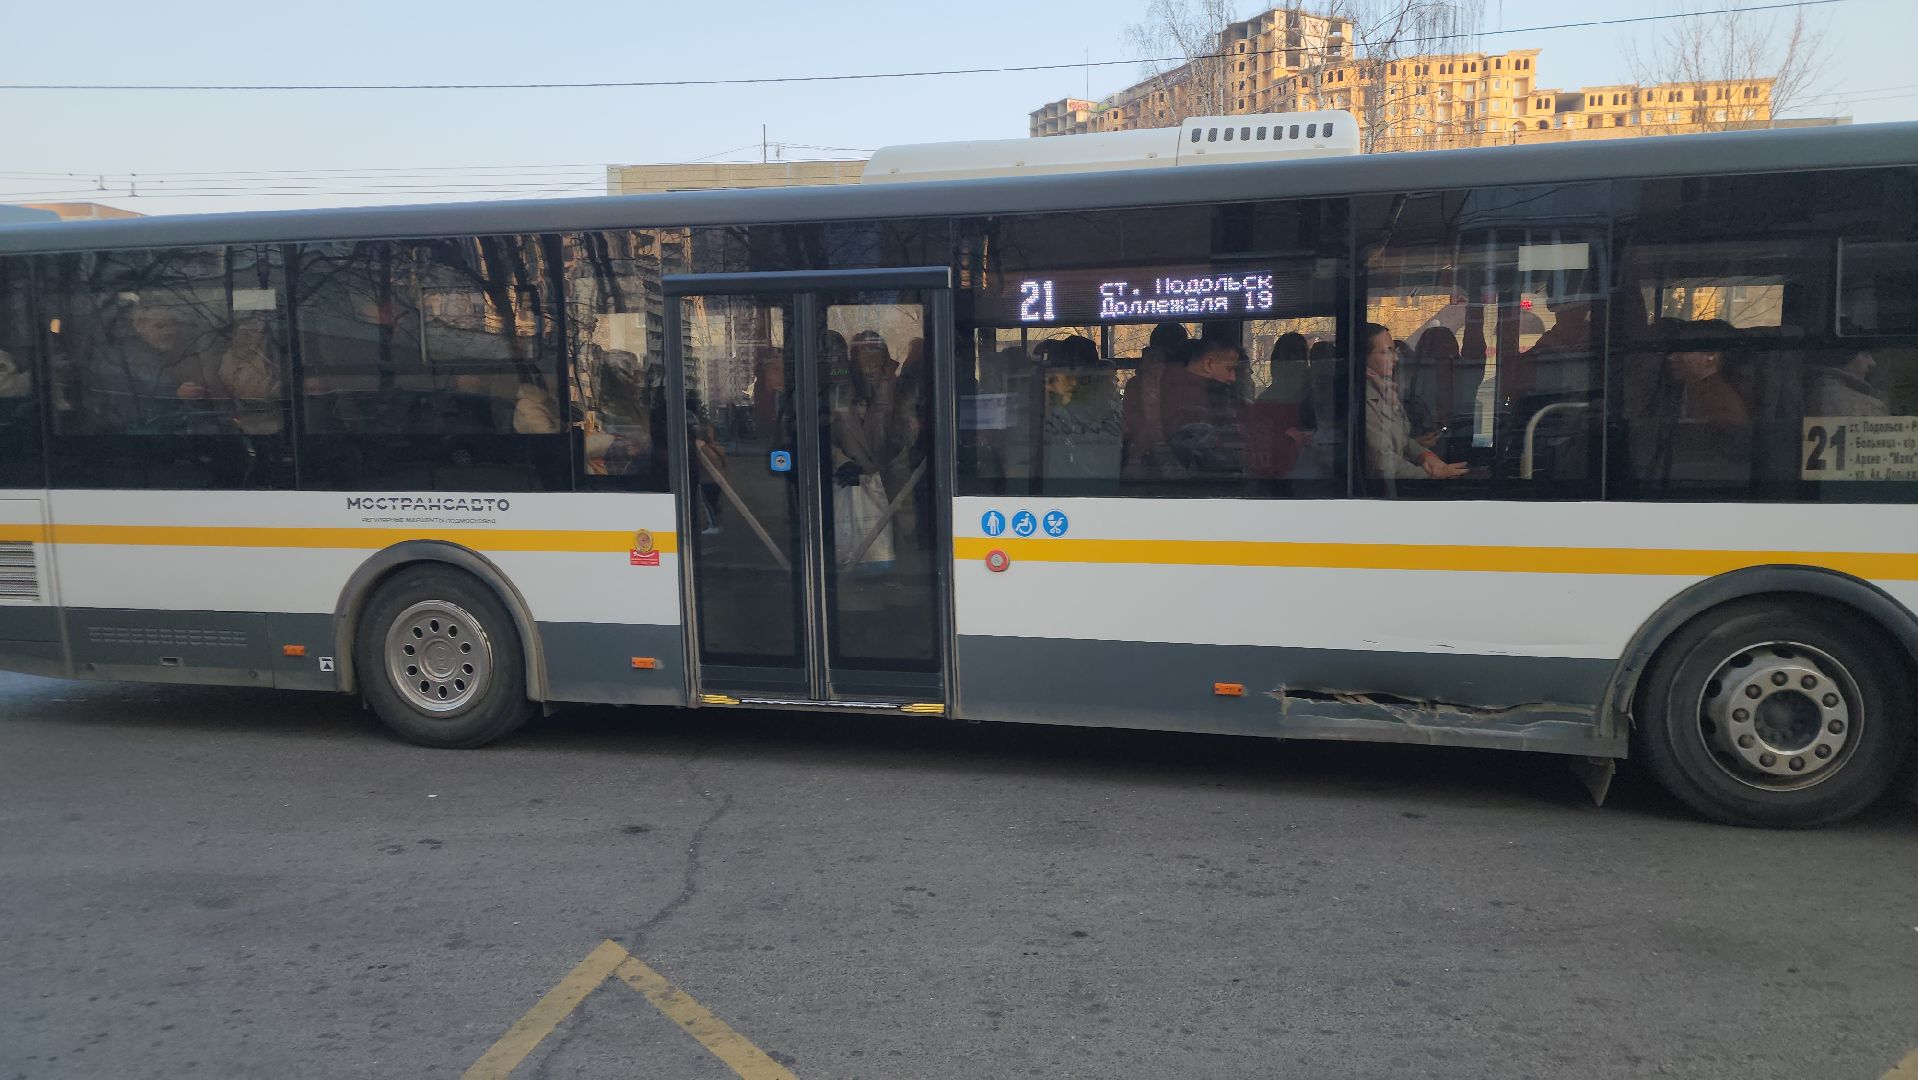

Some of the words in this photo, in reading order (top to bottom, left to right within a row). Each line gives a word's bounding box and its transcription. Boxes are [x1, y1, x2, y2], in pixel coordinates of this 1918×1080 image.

[1156, 275, 1273, 295] Подольск
[1020, 280, 1054, 321] 21
[1100, 296, 1229, 318] Доллежаля
[1245, 290, 1273, 310] 19
[1863, 421, 1904, 434] Подольск
[1805, 425, 1847, 471] 21
[346, 497, 510, 512] МОСТРАНСАВТО
